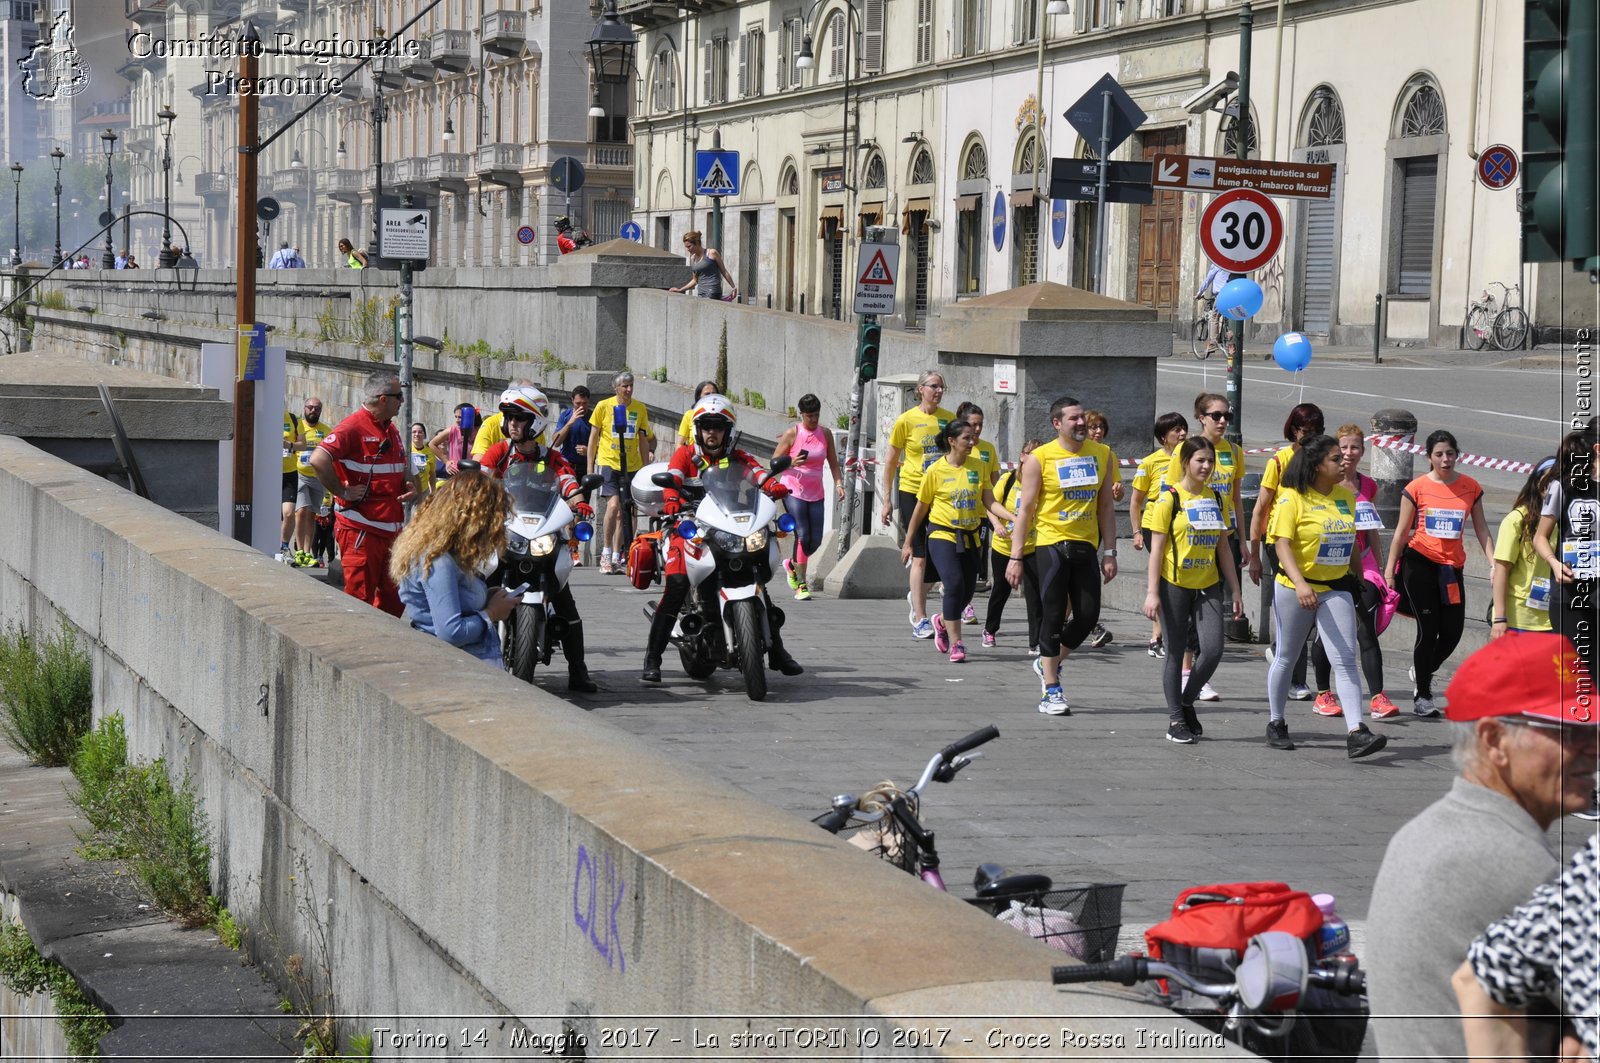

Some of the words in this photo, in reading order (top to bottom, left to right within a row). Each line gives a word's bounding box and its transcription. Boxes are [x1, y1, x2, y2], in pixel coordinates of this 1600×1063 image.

[1218, 165, 1268, 177] navigazione
[1269, 168, 1305, 179] turistica
[1306, 171, 1320, 180] sul
[1217, 177, 1241, 187] fiume
[1242, 179, 1254, 188] Po
[1260, 180, 1295, 191] imbarco
[1296, 183, 1329, 193] Murazzi
[1219, 211, 1266, 250] 30
[856, 291, 894, 299] dissuasore
[1063, 489, 1097, 500] TORINO
[1198, 511, 1218, 521] 4663
[1434, 520, 1453, 530] 4410
[1327, 547, 1345, 557] 4661
